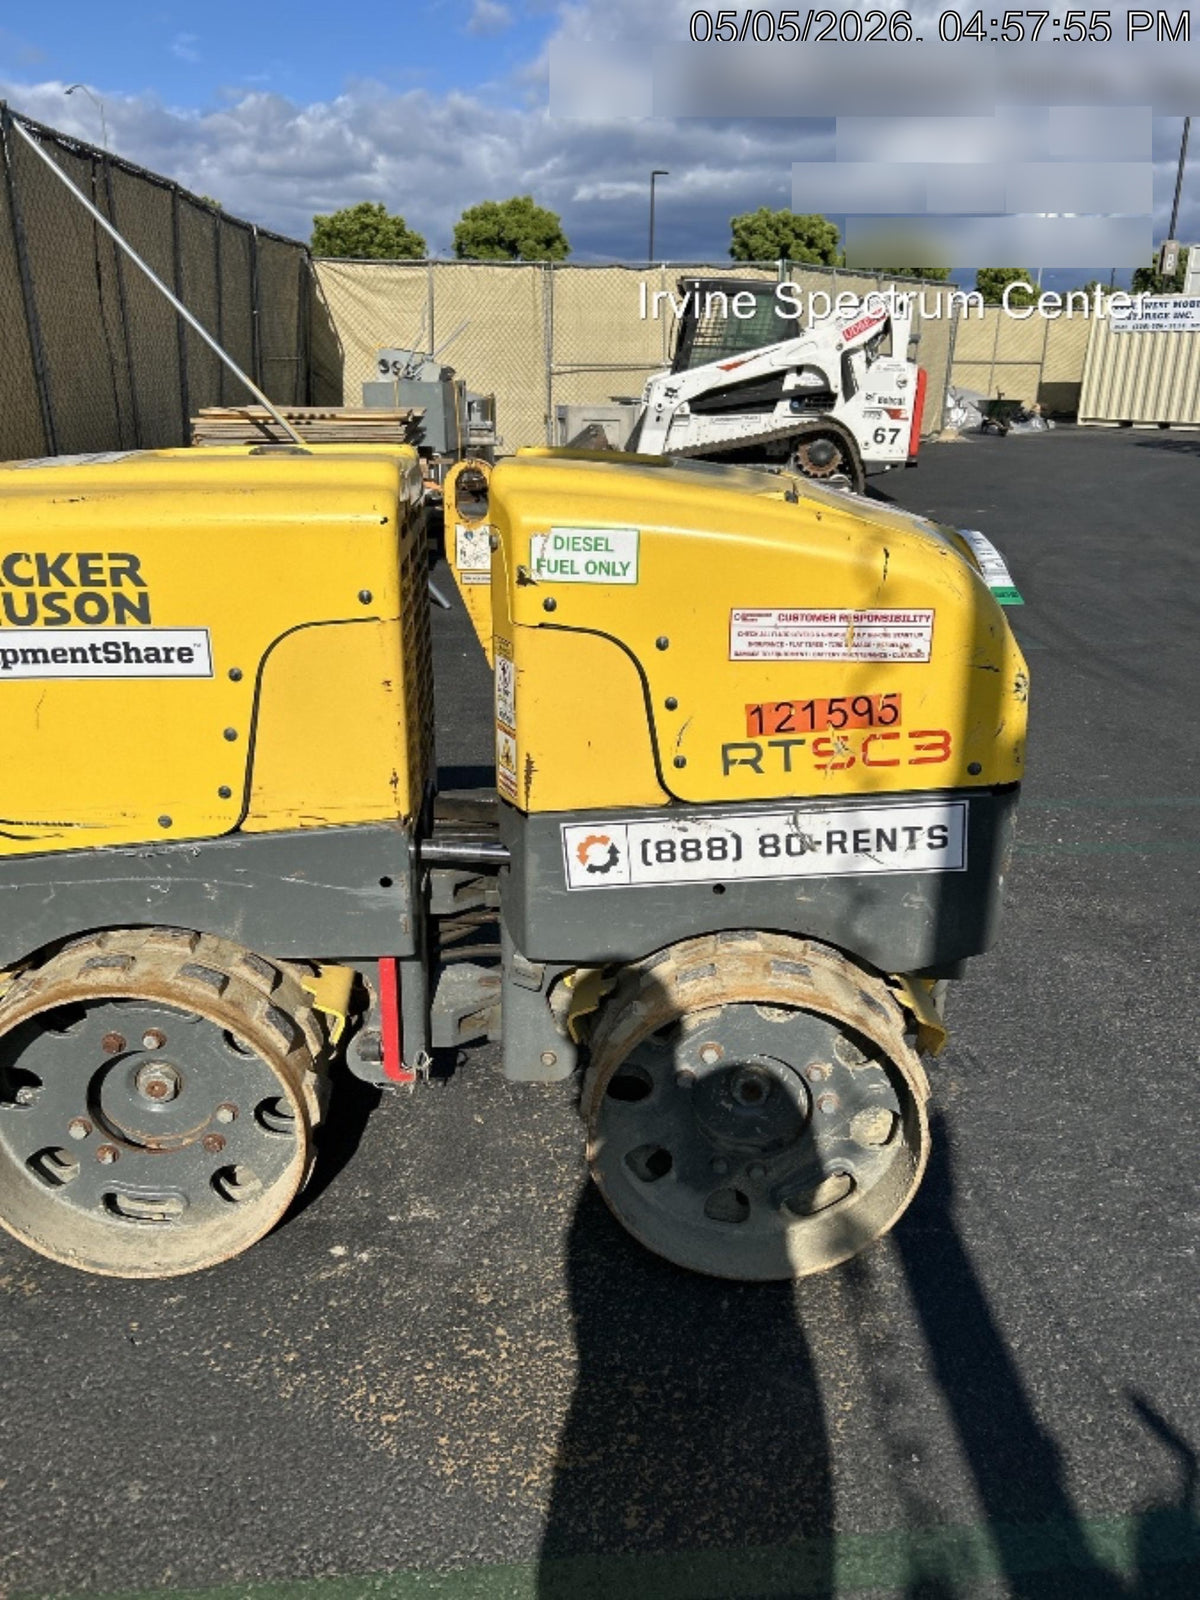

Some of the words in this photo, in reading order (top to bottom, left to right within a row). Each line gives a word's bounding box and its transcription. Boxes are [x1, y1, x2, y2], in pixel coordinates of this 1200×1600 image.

[872, 427, 901, 445] 67
[553, 535, 615, 552] DIESEL
[0, 552, 148, 587] CKER
[536, 558, 580, 575] FUEL
[584, 560, 631, 577] ONLY
[0, 591, 152, 626] USON
[777, 612, 838, 623] CUSTOMER
[750, 693, 899, 735] 121595
[641, 832, 742, 866] (888)
[758, 824, 949, 858] 80-RENTS
